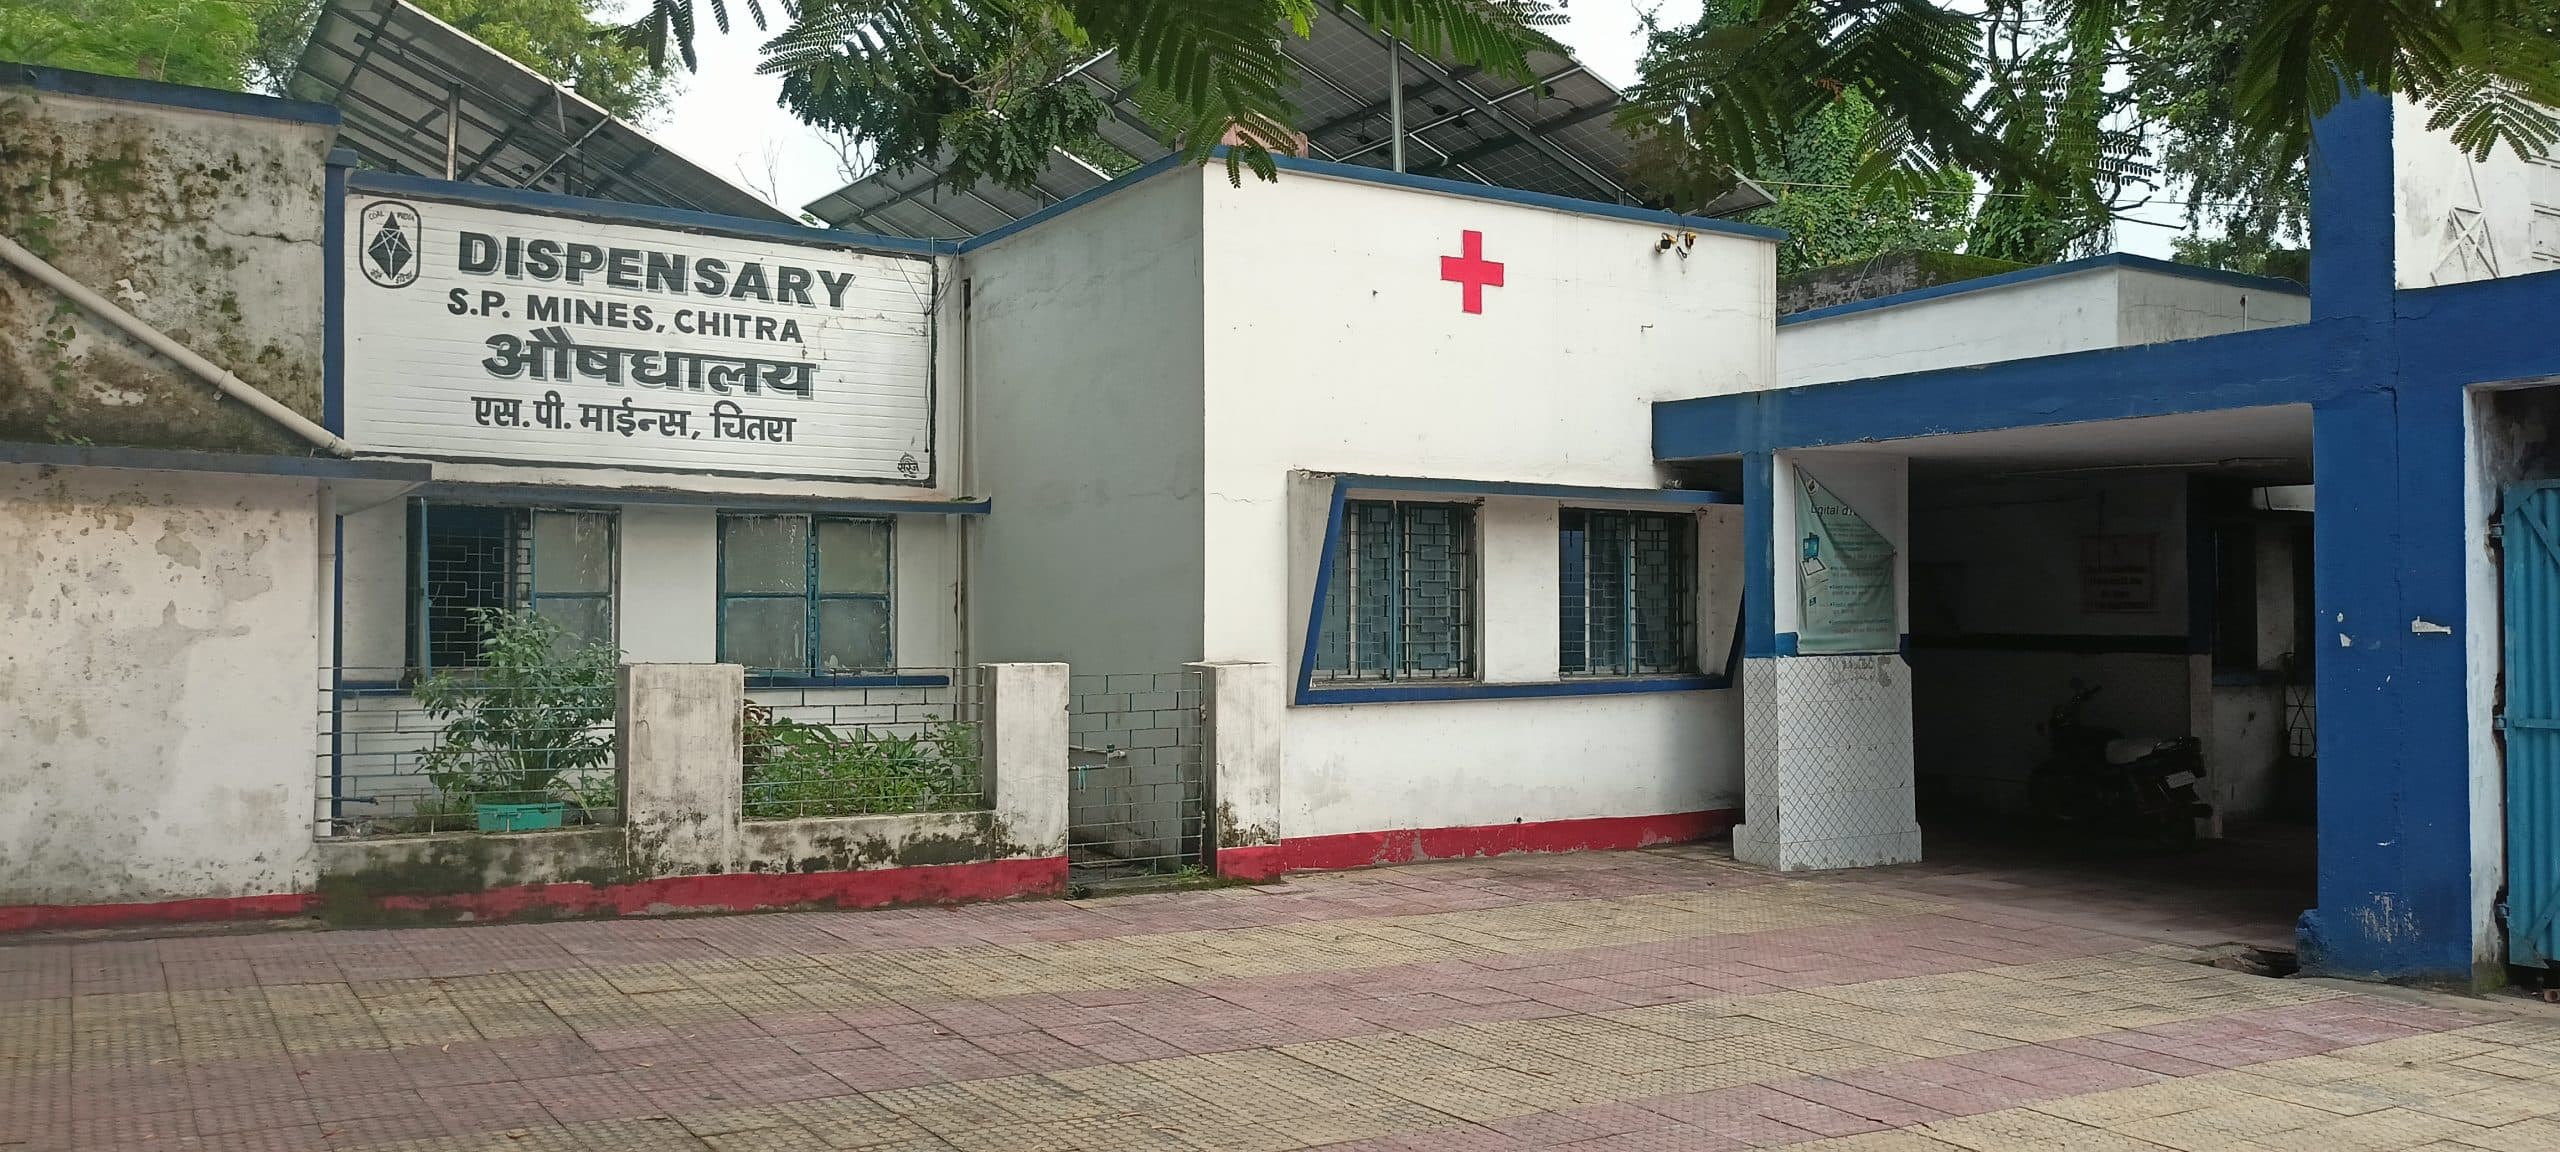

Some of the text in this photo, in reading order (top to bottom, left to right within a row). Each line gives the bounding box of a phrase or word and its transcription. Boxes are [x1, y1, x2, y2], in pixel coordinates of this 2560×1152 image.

[368, 210, 385, 221] COAL
[458, 230, 857, 311] DISPENSARY
[446, 287, 804, 344] S.P. MINES, CHITRA
[481, 325, 821, 400] औषधालय
[578, 397, 701, 440] माईन्स,
[709, 400, 798, 443] चितरा
[1811, 505, 1839, 517] Dgital
